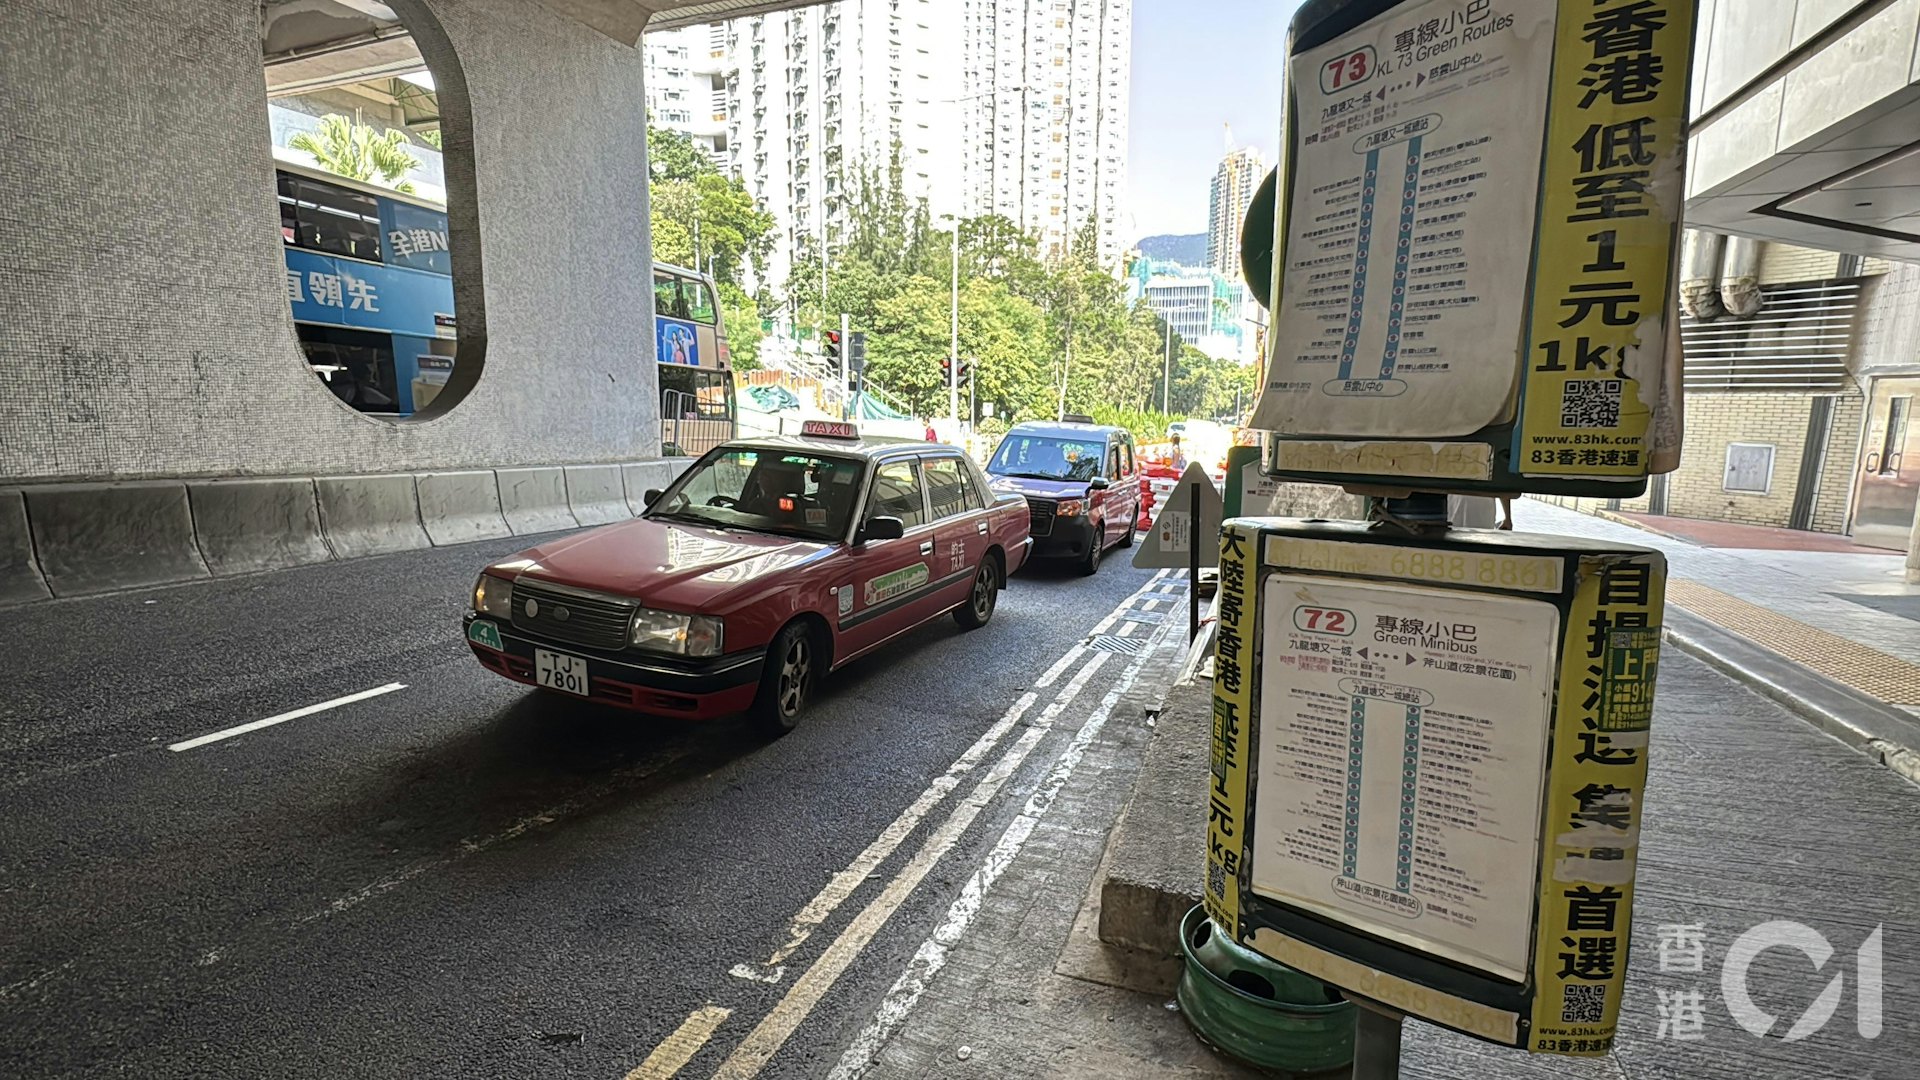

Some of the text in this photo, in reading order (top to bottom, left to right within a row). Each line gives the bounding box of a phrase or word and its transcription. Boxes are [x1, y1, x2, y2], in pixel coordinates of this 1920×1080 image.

[1394, 0, 1490, 53] 專線小巴
[1397, 52, 1413, 70] 73
[1416, 36, 1458, 62] Green
[1462, 13, 1514, 45] Routes
[1577, 0, 1667, 109] 香港
[1328, 51, 1367, 89] 73
[1429, 52, 1483, 80] 慈雲山中心
[1321, 90, 1373, 120] 九龍塘又一城
[1557, 117, 1656, 329] 低至1元
[806, 422, 852, 435] TAXI
[1532, 434, 1641, 445] www.83hk.com
[1531, 449, 1640, 466] 83香港速運
[951, 555, 965, 571] TAXI
[1390, 552, 1465, 581] 6888
[1217, 527, 1246, 695] 大陸寄香港
[1304, 609, 1346, 632] 72
[480, 627, 489, 638] 4
[1375, 615, 1477, 643] 專線小巴
[1289, 639, 1352, 656] 九龍塘又一城
[1373, 631, 1477, 655] Green Minibus
[550, 654, 572, 674] TJ
[1423, 657, 1517, 681] 斧山道(宏景花園)
[542, 668, 582, 693] 7801
[1556, 783, 1632, 981] 集首選
